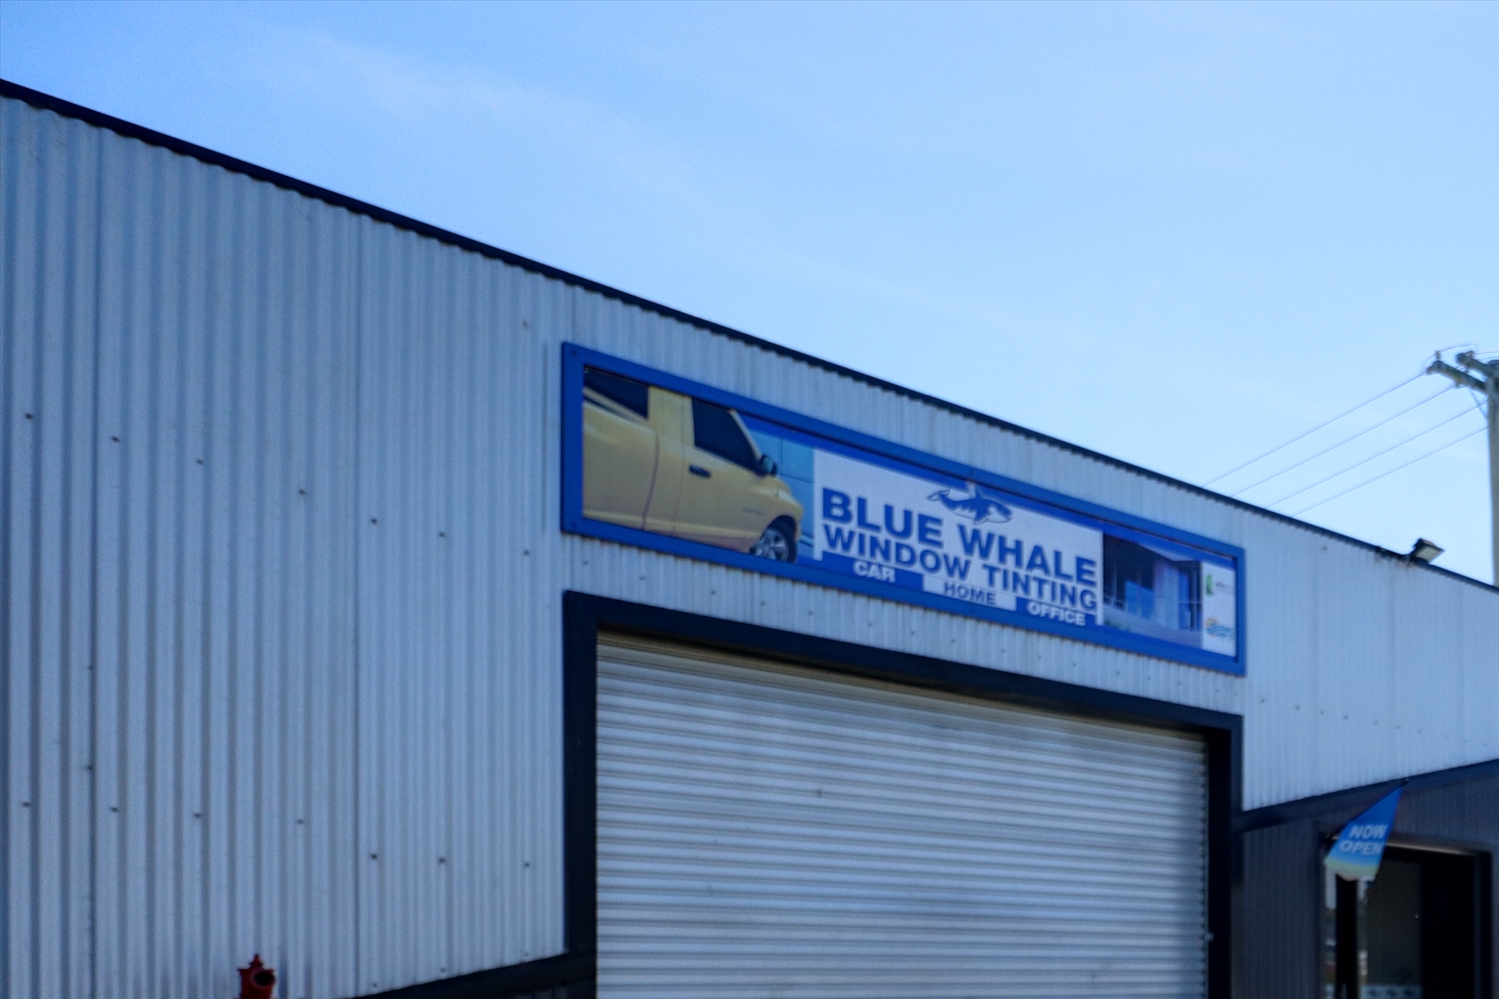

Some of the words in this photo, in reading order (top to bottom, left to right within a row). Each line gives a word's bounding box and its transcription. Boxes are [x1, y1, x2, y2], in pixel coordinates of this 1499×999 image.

[822, 487, 944, 549] BLUE
[957, 523, 1097, 587] WHALE
[823, 523, 971, 581] WINDOW
[982, 563, 1097, 612] TINTING
[853, 560, 896, 582] CAR
[944, 582, 997, 606] HOME
[1028, 601, 1086, 627] OFFICE
[1349, 824, 1388, 839] NOW
[1339, 840, 1383, 855] OPEN
